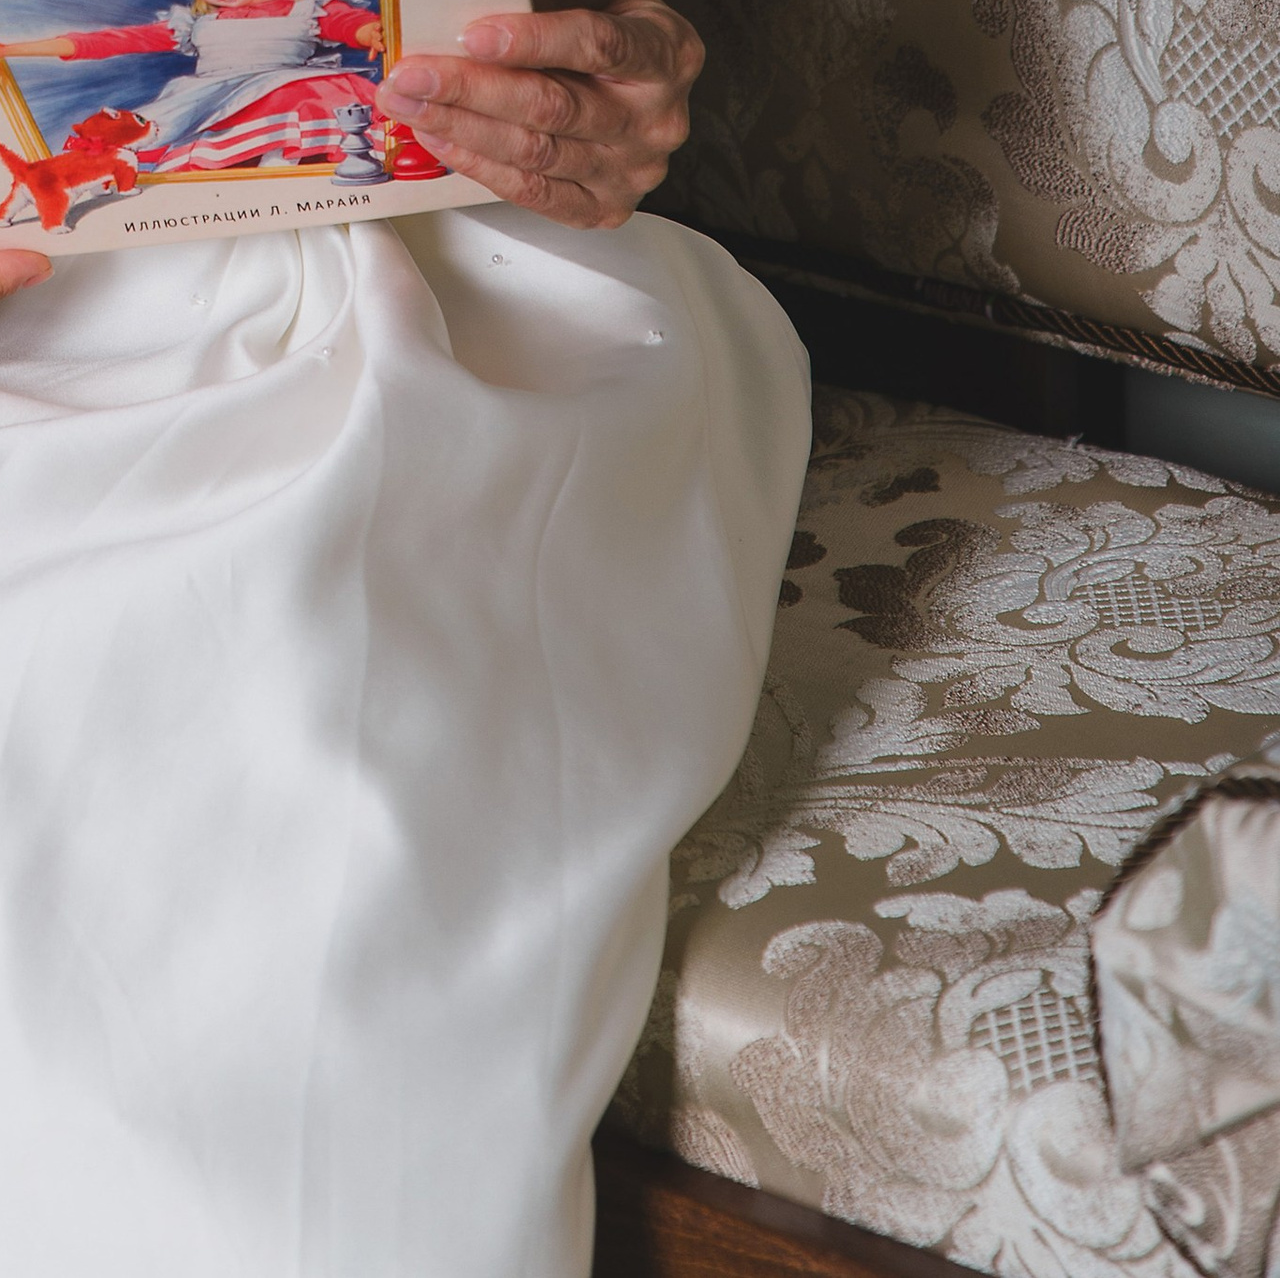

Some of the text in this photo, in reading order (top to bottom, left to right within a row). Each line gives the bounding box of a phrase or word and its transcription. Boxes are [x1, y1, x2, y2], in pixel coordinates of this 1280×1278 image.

[124, 194, 372, 233] ИЛЛЮСТРАЦИИ Л. МАРАЙЯ
